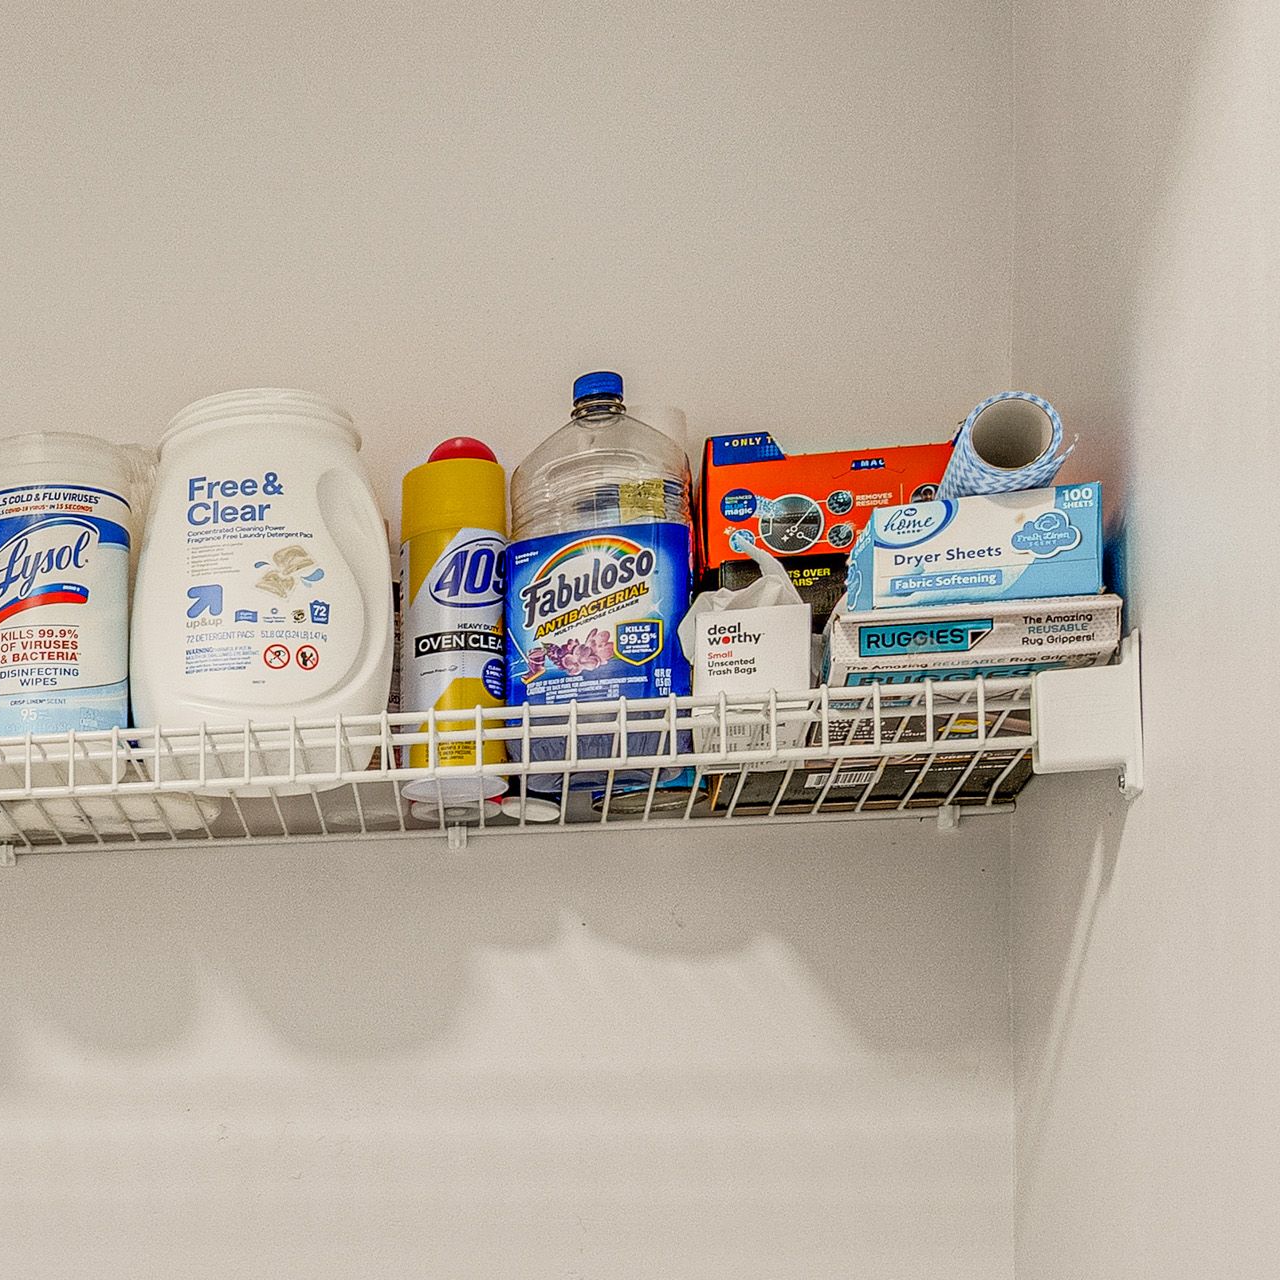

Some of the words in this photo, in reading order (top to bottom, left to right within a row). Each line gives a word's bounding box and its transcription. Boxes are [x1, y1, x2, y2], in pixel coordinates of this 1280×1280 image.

[731, 437, 763, 447] ONLY
[189, 477, 258, 501] Free
[263, 472, 284, 495] &
[9, 494, 32, 504] COLD
[42, 493, 60, 501] FLU
[1062, 488, 1093, 500] 100
[1063, 500, 1093, 509] SHEETS
[187, 501, 271, 526] Clear
[725, 508, 752, 516] magic
[884, 510, 935, 533] home
[188, 527, 234, 537] Concentrated
[1016, 532, 1041, 542] Fresh
[187, 534, 221, 544] Fragrance
[894, 552, 941, 567] Dryer
[946, 546, 1002, 561] Sheets
[895, 578, 932, 590] Fabric
[935, 573, 996, 587] Softening
[522, 550, 653, 628] Fabuloso
[313, 605, 327, 616] 72
[534, 582, 649, 641] ANTIBACTERIAL
[186, 618, 222, 629] up&up
[554, 611, 607, 637] MULTI-PURPOSE
[608, 598, 640, 614] CLEANER
[1023, 616, 1042, 624] The
[1046, 614, 1093, 624] Amazing
[484, 625, 499, 633] DUTY
[708, 623, 741, 635] deal
[1028, 623, 1088, 634] REUSABLE
[1, 630, 34, 642] KILLS
[38, 629, 79, 639] 99.9%
[620, 632, 657, 644] 99.9%
[708, 632, 762, 646] worthy
[866, 628, 964, 649] RUGGIES
[1022, 636, 1043, 646] Rug
[1047, 633, 1095, 646] Grippers!
[1, 642, 16, 652] OF
[21, 640, 78, 650] VIRUSES
[419, 637, 465, 651] OVEN
[468, 634, 503, 650] CLEA
[0, 655, 8, 664] &
[12, 651, 78, 662] BACTERIA
[708, 651, 733, 659] Small
[708, 657, 755, 668] Unscented
[0, 668, 79, 679] DISINFECTING
[708, 668, 732, 676] Trash
[734, 666, 757, 674] Bags
[20, 678, 57, 687] WIPES
[21, 708, 37, 721] 95
